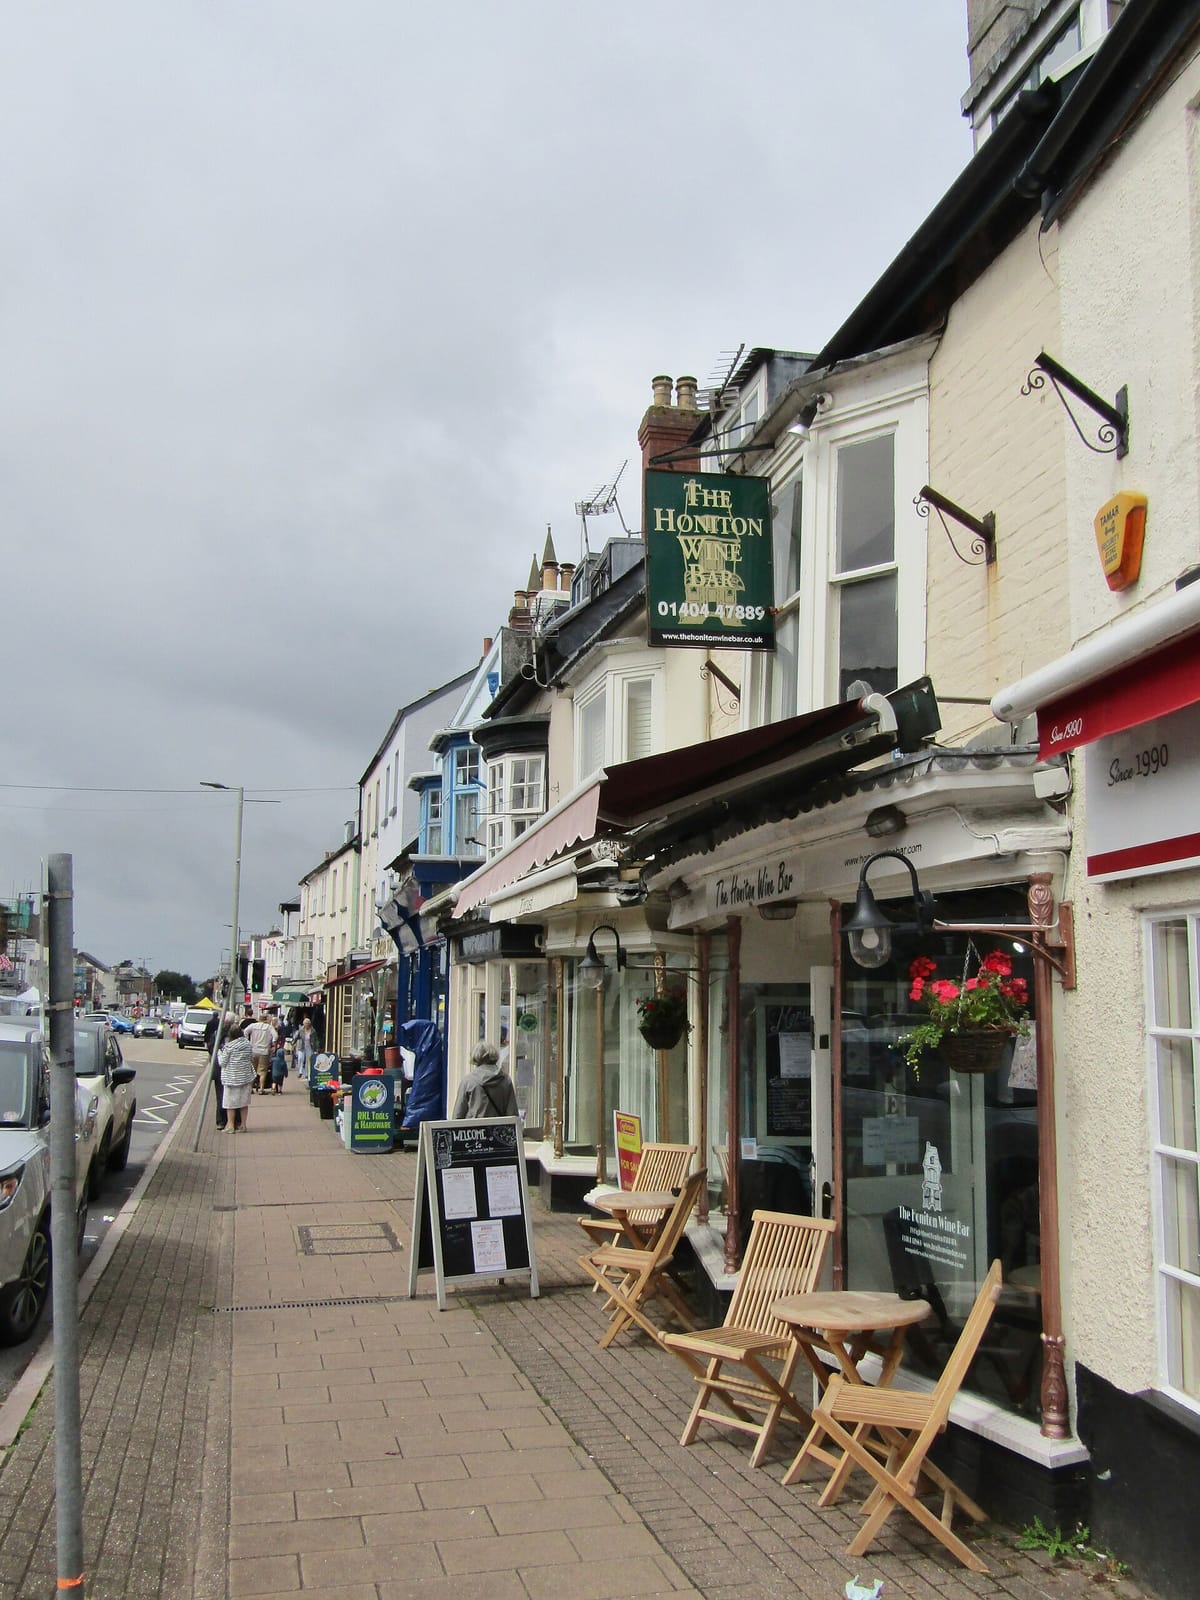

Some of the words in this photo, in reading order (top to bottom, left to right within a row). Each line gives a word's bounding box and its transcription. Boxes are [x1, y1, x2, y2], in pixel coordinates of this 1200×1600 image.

[684, 480, 733, 508] THE
[654, 508, 763, 537] HONITON
[678, 537, 743, 562] WINE
[657, 601, 709, 618] 01404
[715, 604, 766, 620] 47889
[661, 632, 764, 644] www.thehonitonwinebar.co.uk
[1063, 718, 1083, 739] 1990
[1107, 758, 1134, 787] Since
[1135, 743, 1169, 777] 1990
[716, 880, 728, 909] The
[757, 866, 775, 900] Wine
[778, 861, 793, 893] Bar
[453, 1129, 486, 1142] WELCOME
[938, 1215, 956, 1234] Wine
